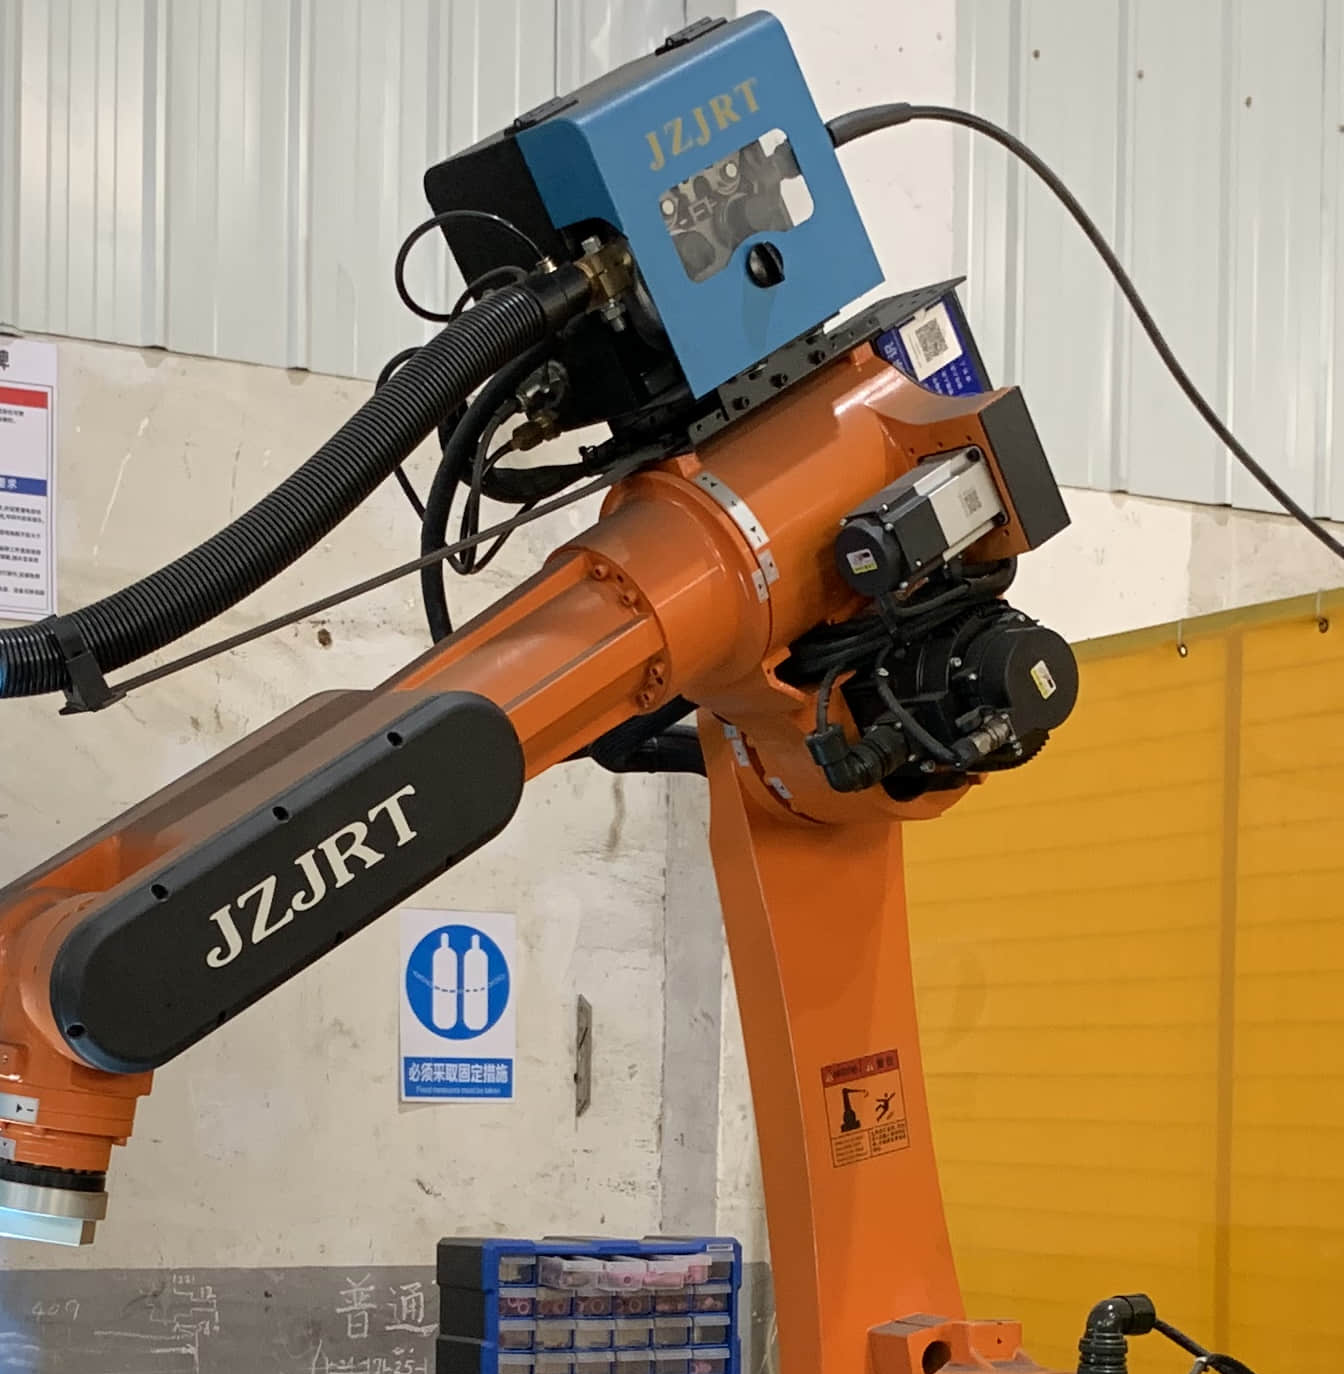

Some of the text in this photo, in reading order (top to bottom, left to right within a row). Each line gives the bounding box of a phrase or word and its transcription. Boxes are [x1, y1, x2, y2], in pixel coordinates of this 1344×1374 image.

[645, 77, 760, 171] JZJRT
[206, 784, 417, 968] JZJRT
[408, 1062, 509, 1083] 必须采取固定措施
[336, 1273, 439, 1338] 普通
